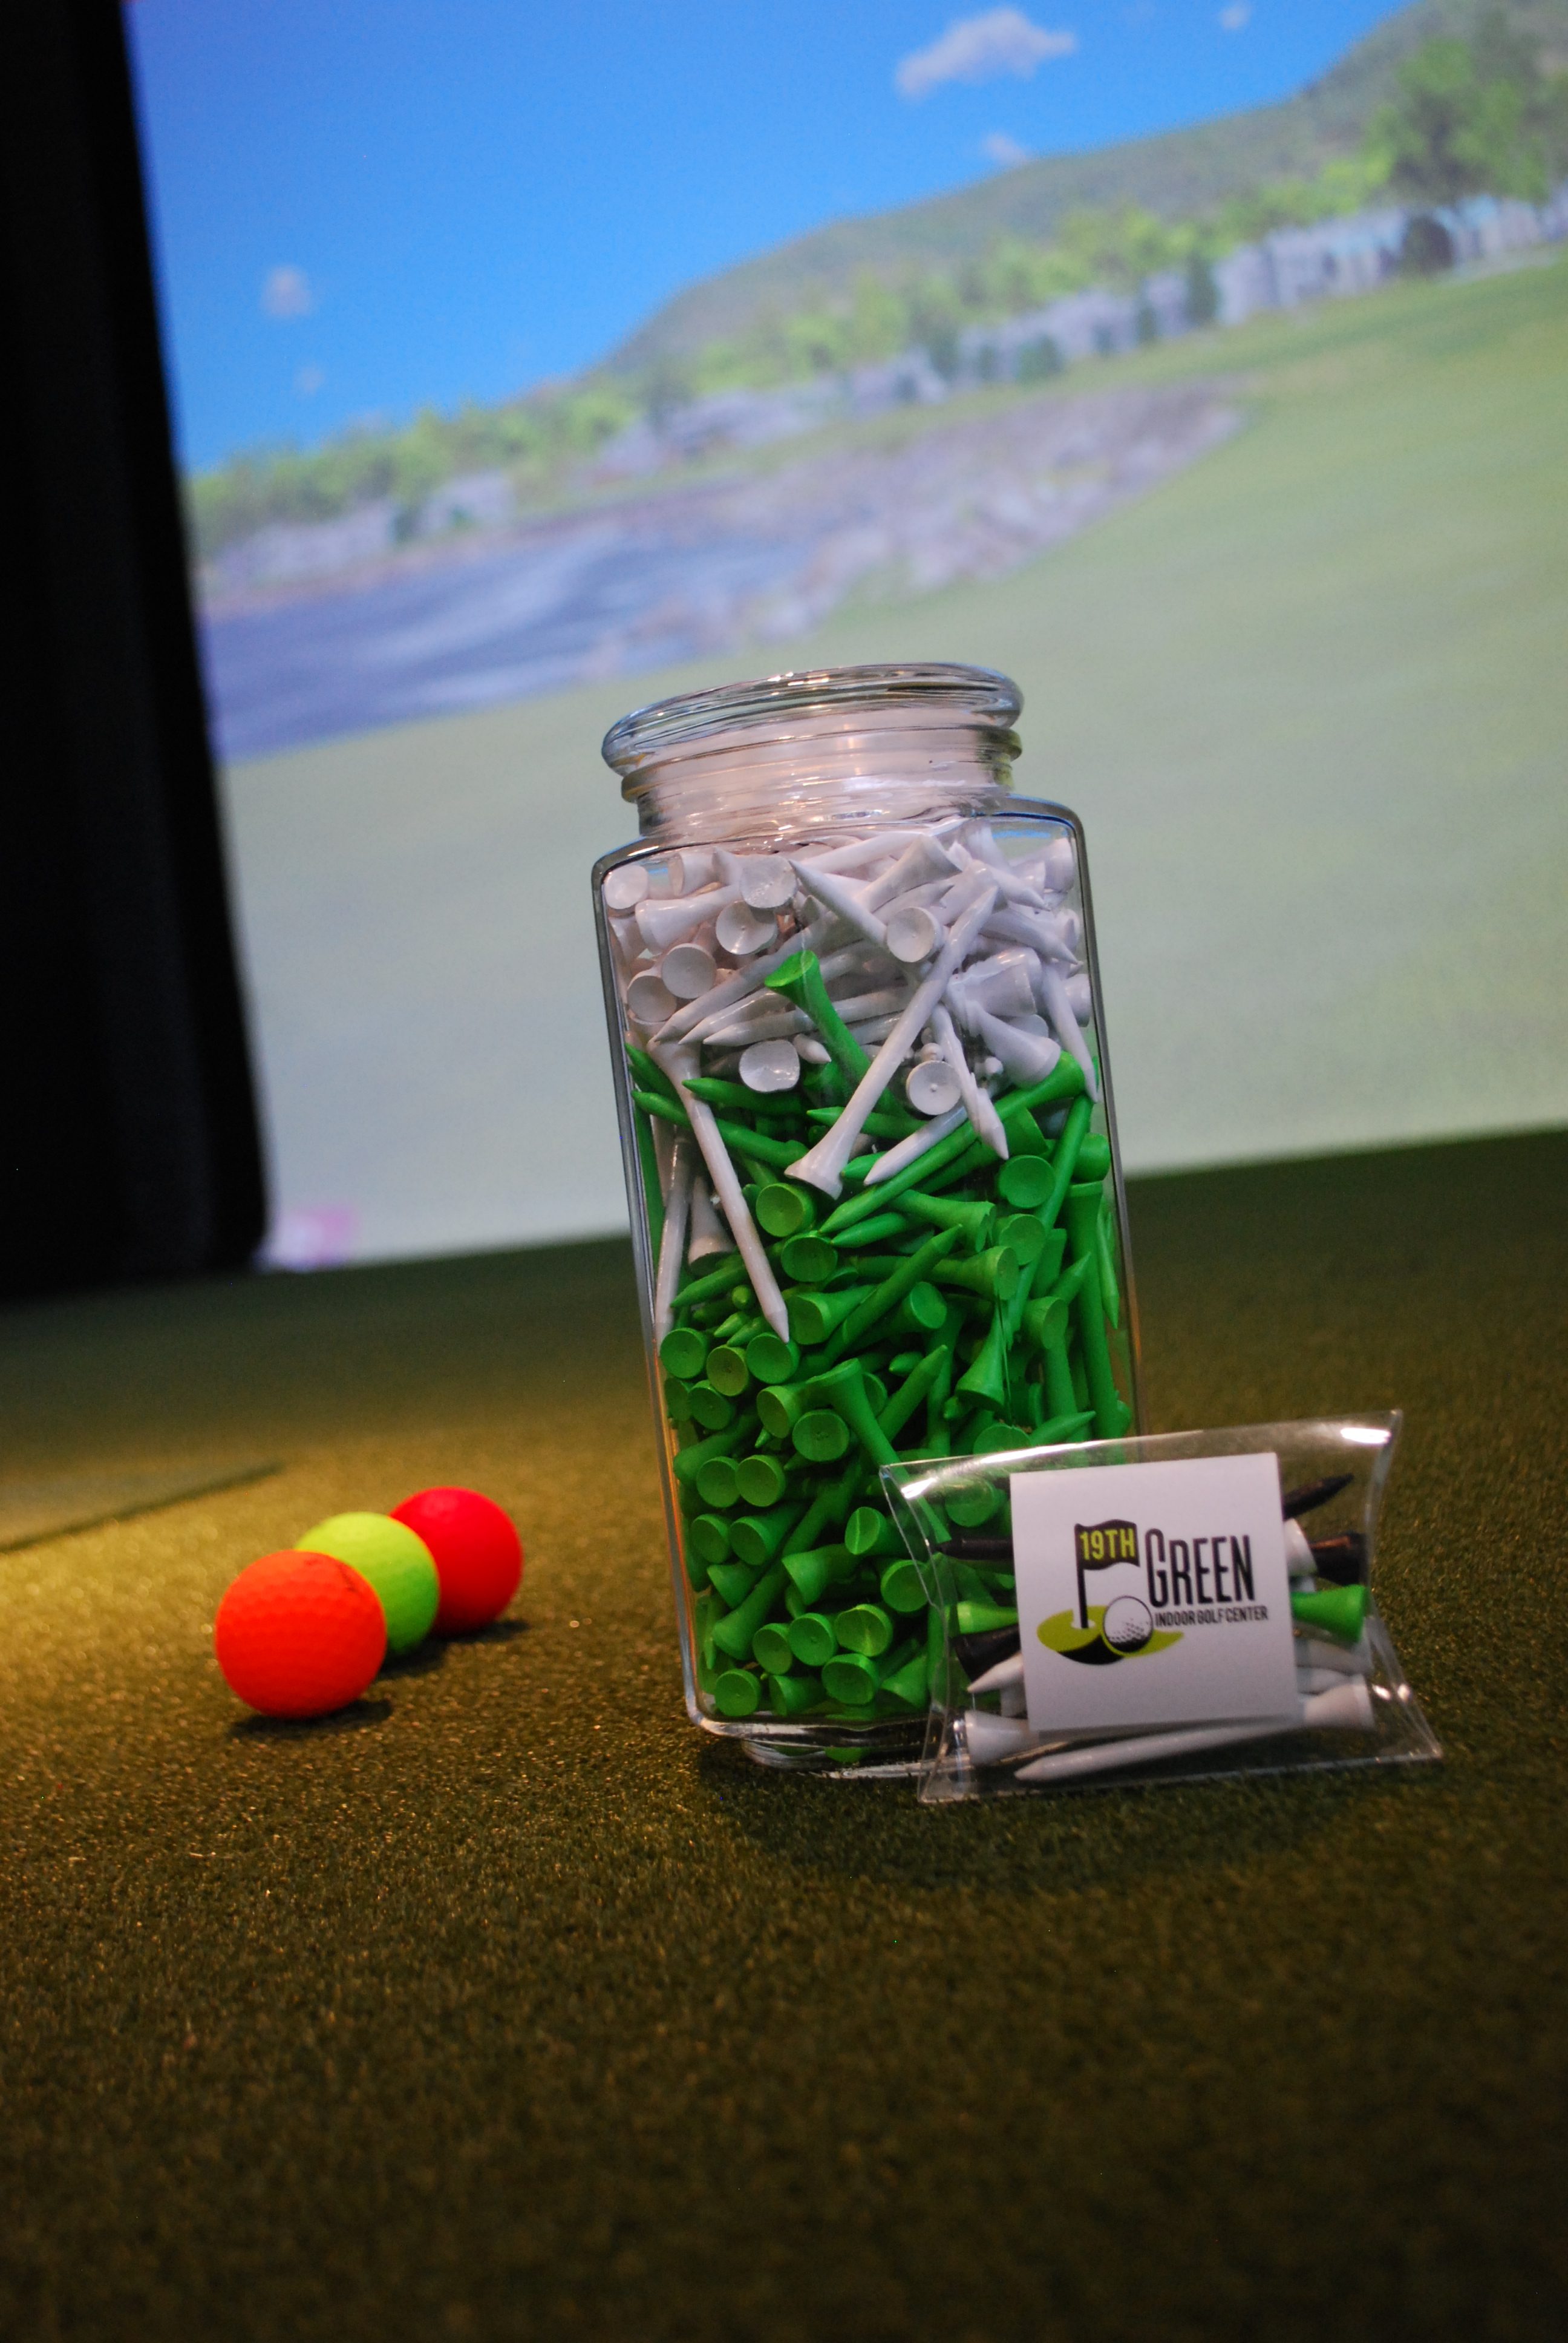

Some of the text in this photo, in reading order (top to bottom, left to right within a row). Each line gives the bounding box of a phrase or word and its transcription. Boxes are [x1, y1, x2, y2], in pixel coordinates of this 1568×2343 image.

[1079, 1527, 1255, 1608] 19TH GREEN
[1155, 1605, 1269, 1627] INDOOR GOLF CENTER
